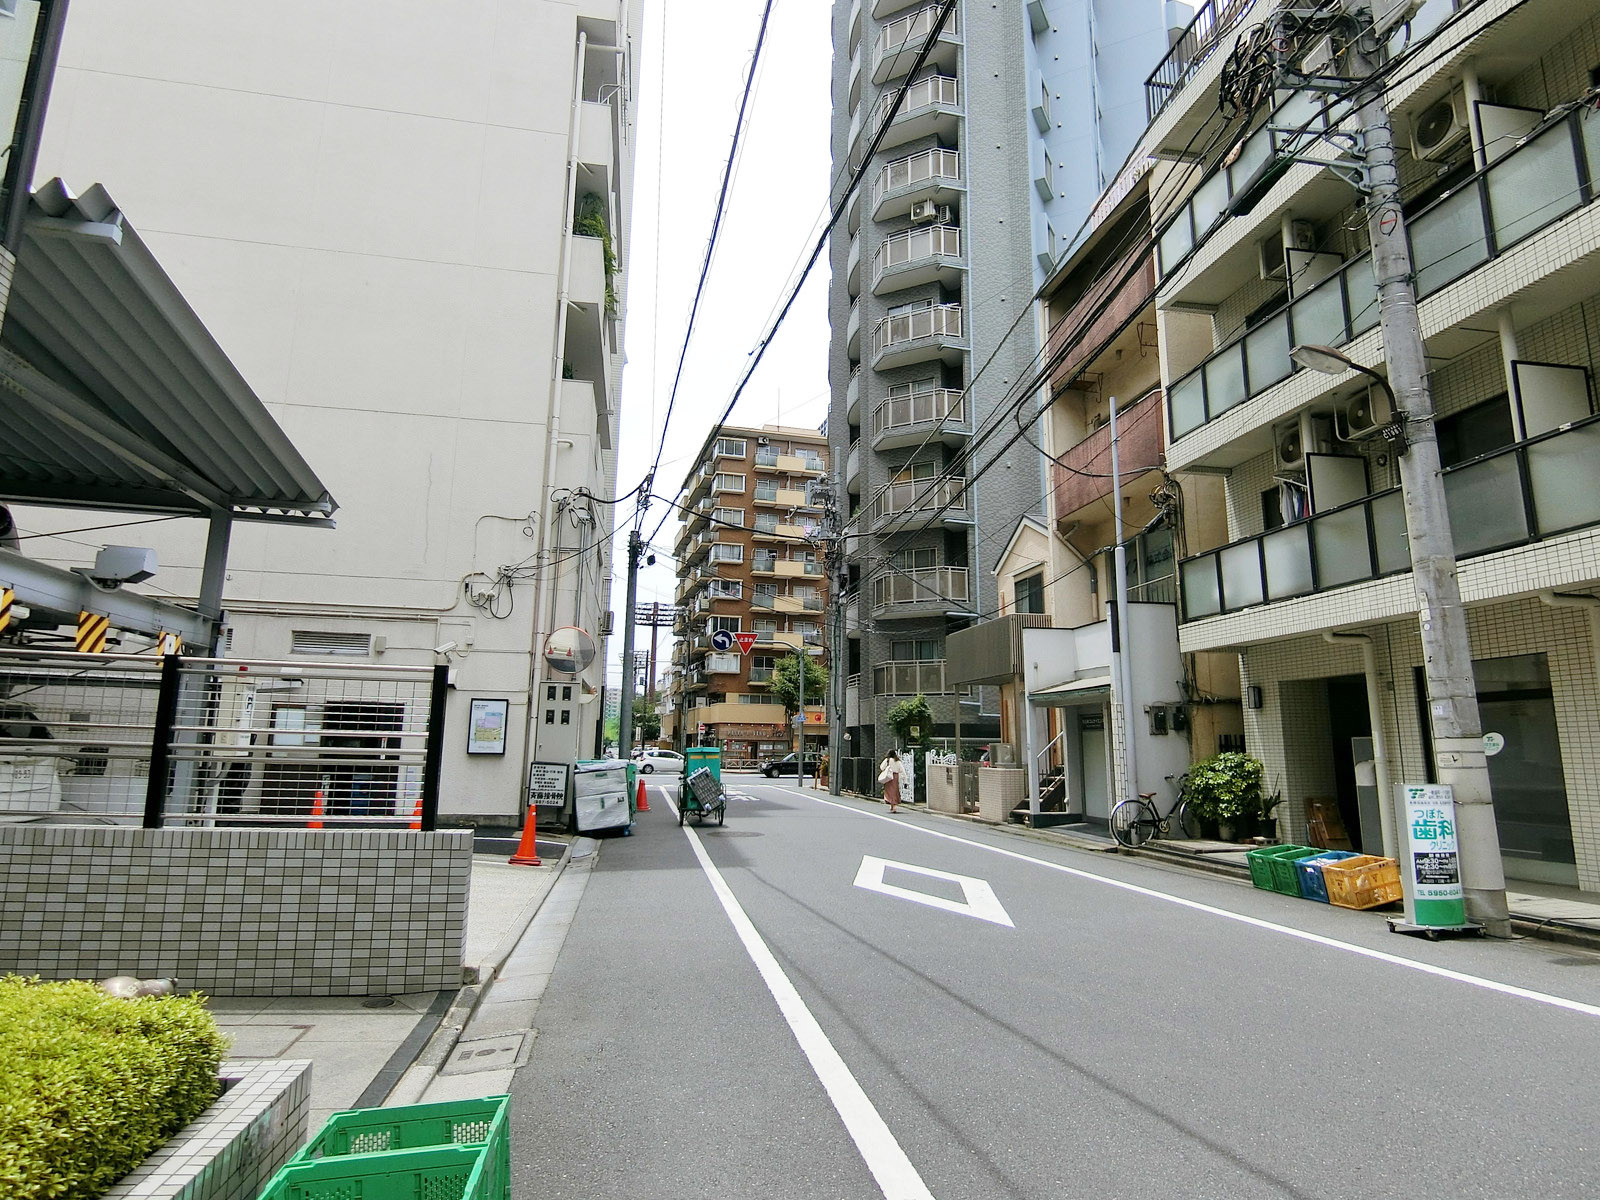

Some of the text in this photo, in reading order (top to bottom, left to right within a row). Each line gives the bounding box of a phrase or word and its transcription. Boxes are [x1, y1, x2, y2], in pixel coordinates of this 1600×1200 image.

[1413, 808, 1445, 819] つぼた
[1411, 819, 1455, 840] 歯科
[1429, 840, 1456, 851] クリニック
